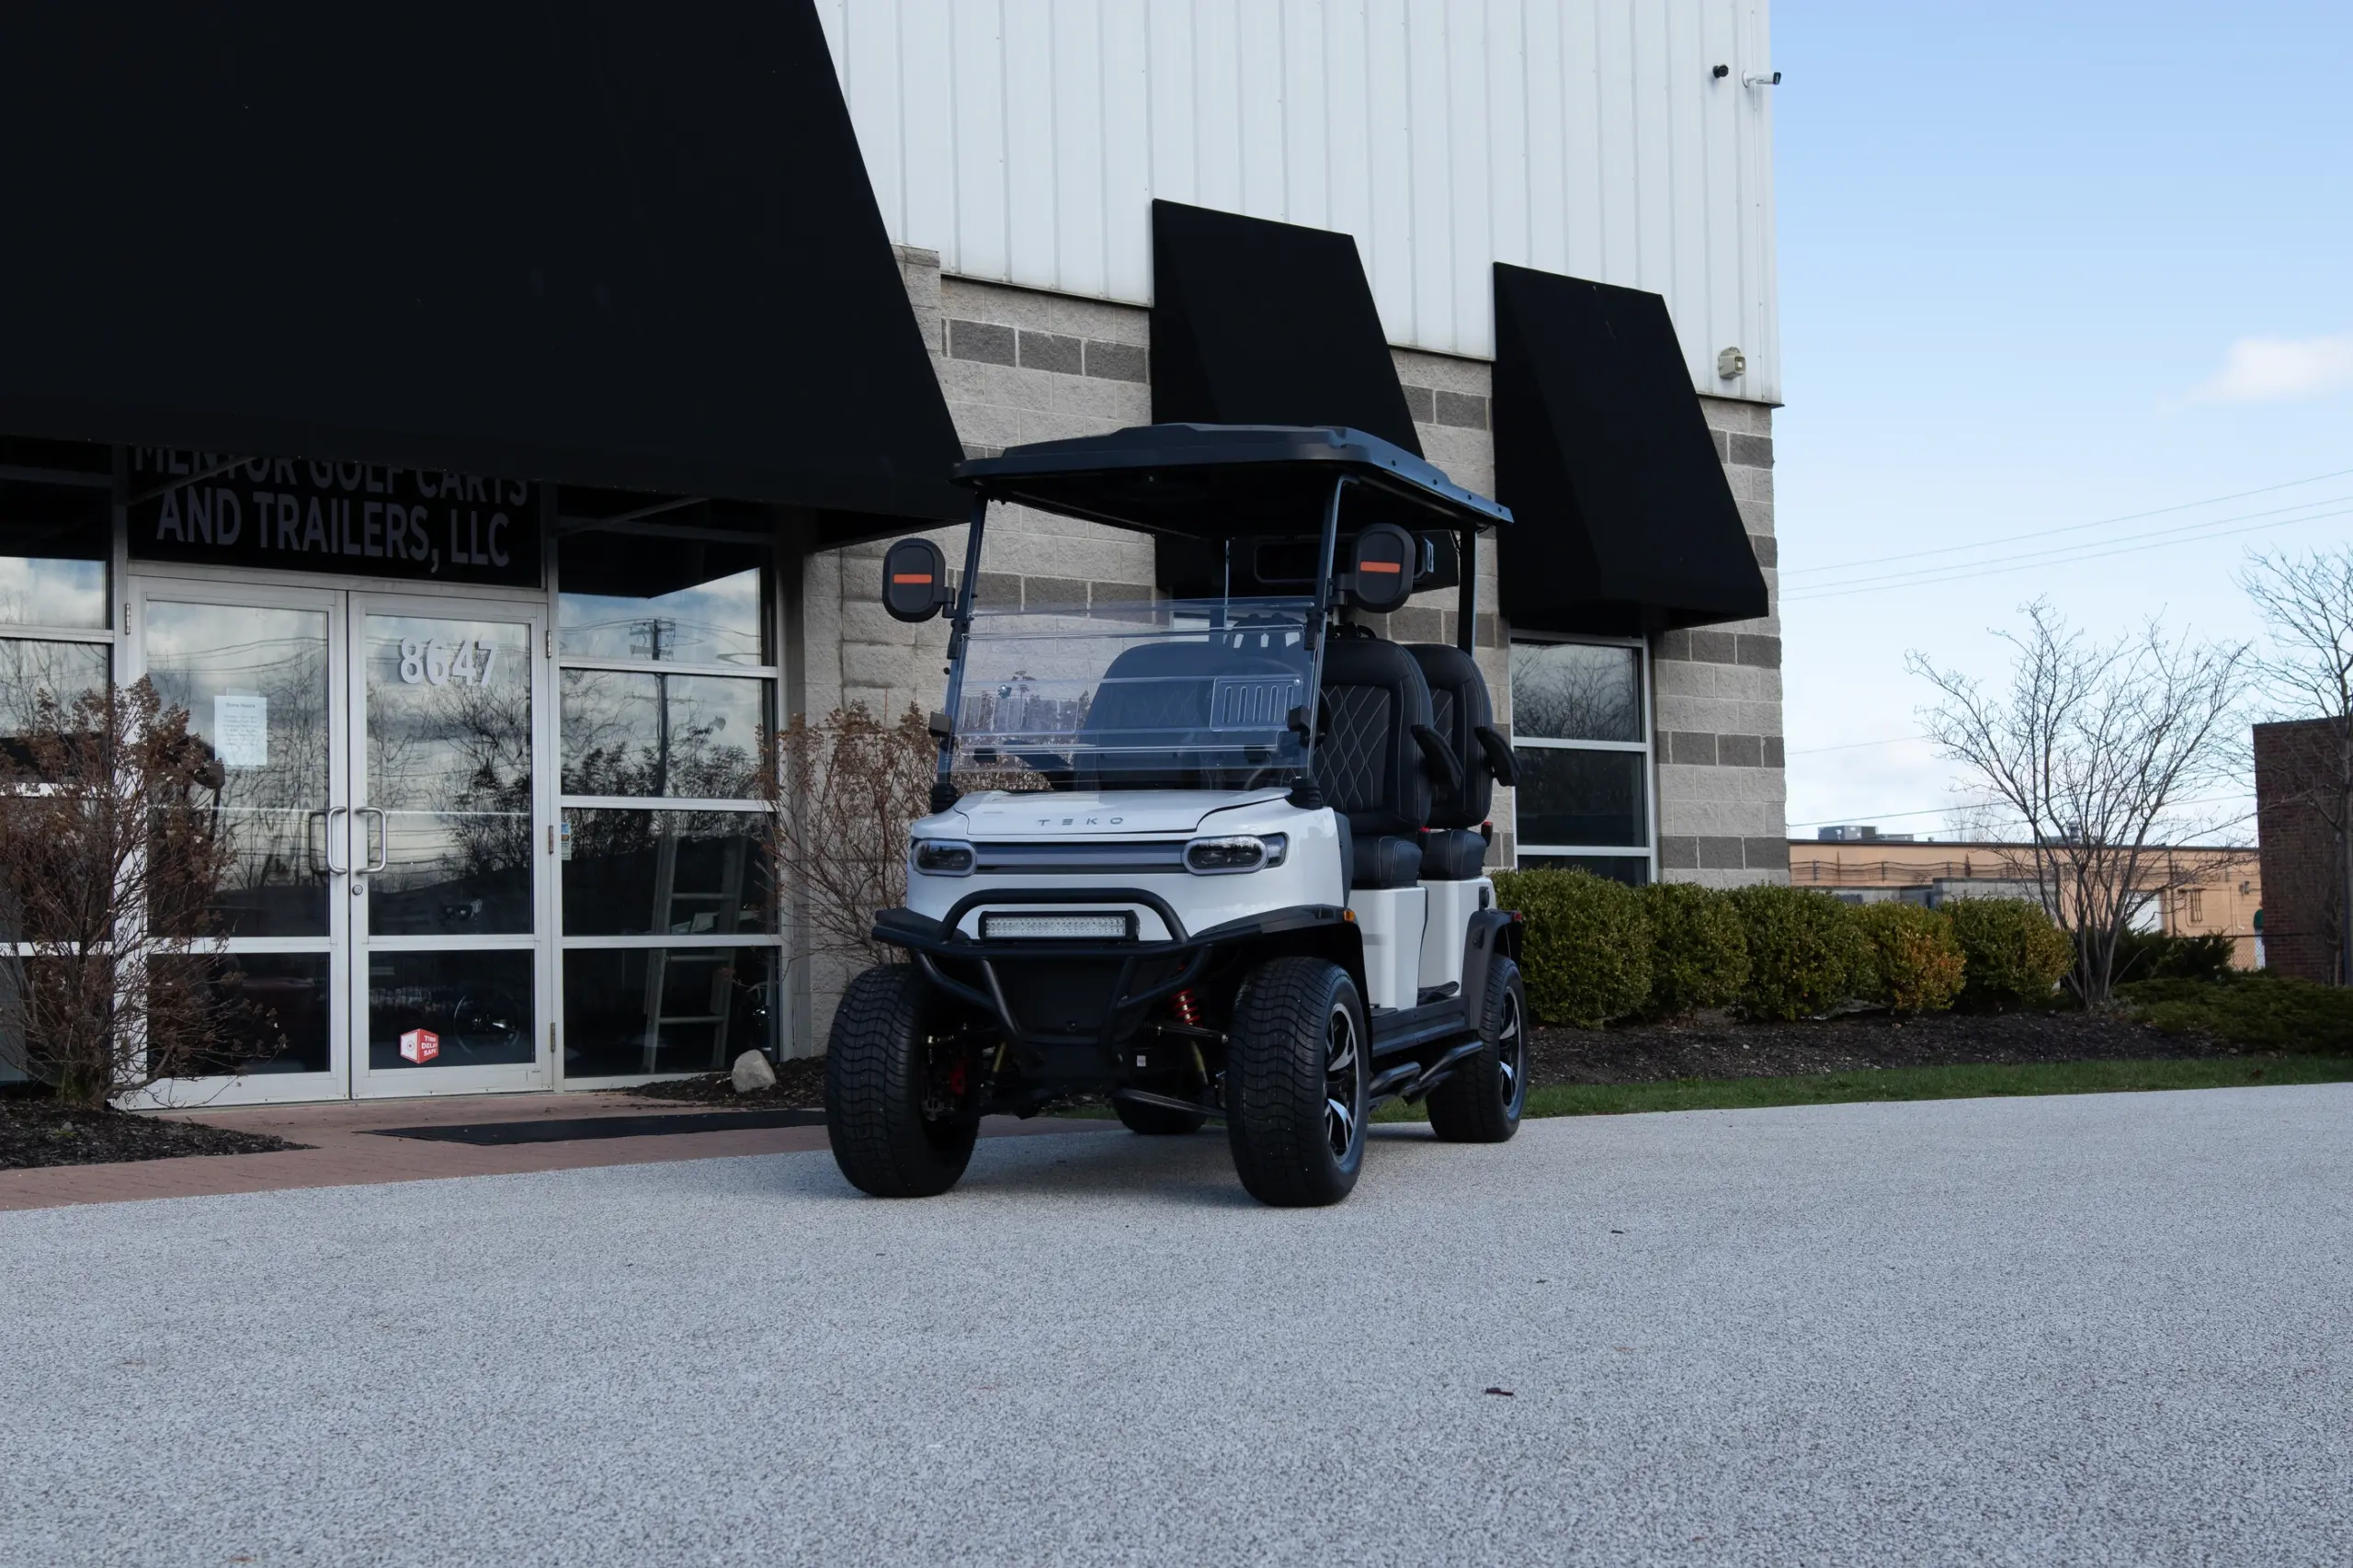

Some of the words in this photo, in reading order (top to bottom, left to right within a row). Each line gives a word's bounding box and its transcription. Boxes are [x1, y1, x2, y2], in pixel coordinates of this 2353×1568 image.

[135, 446, 299, 485] MEOR
[156, 484, 242, 546] AND
[253, 490, 438, 574] TRAILERS,
[450, 507, 510, 568] LLC
[399, 637, 498, 687] 8647
[1038, 817, 1123, 826] TEKO
